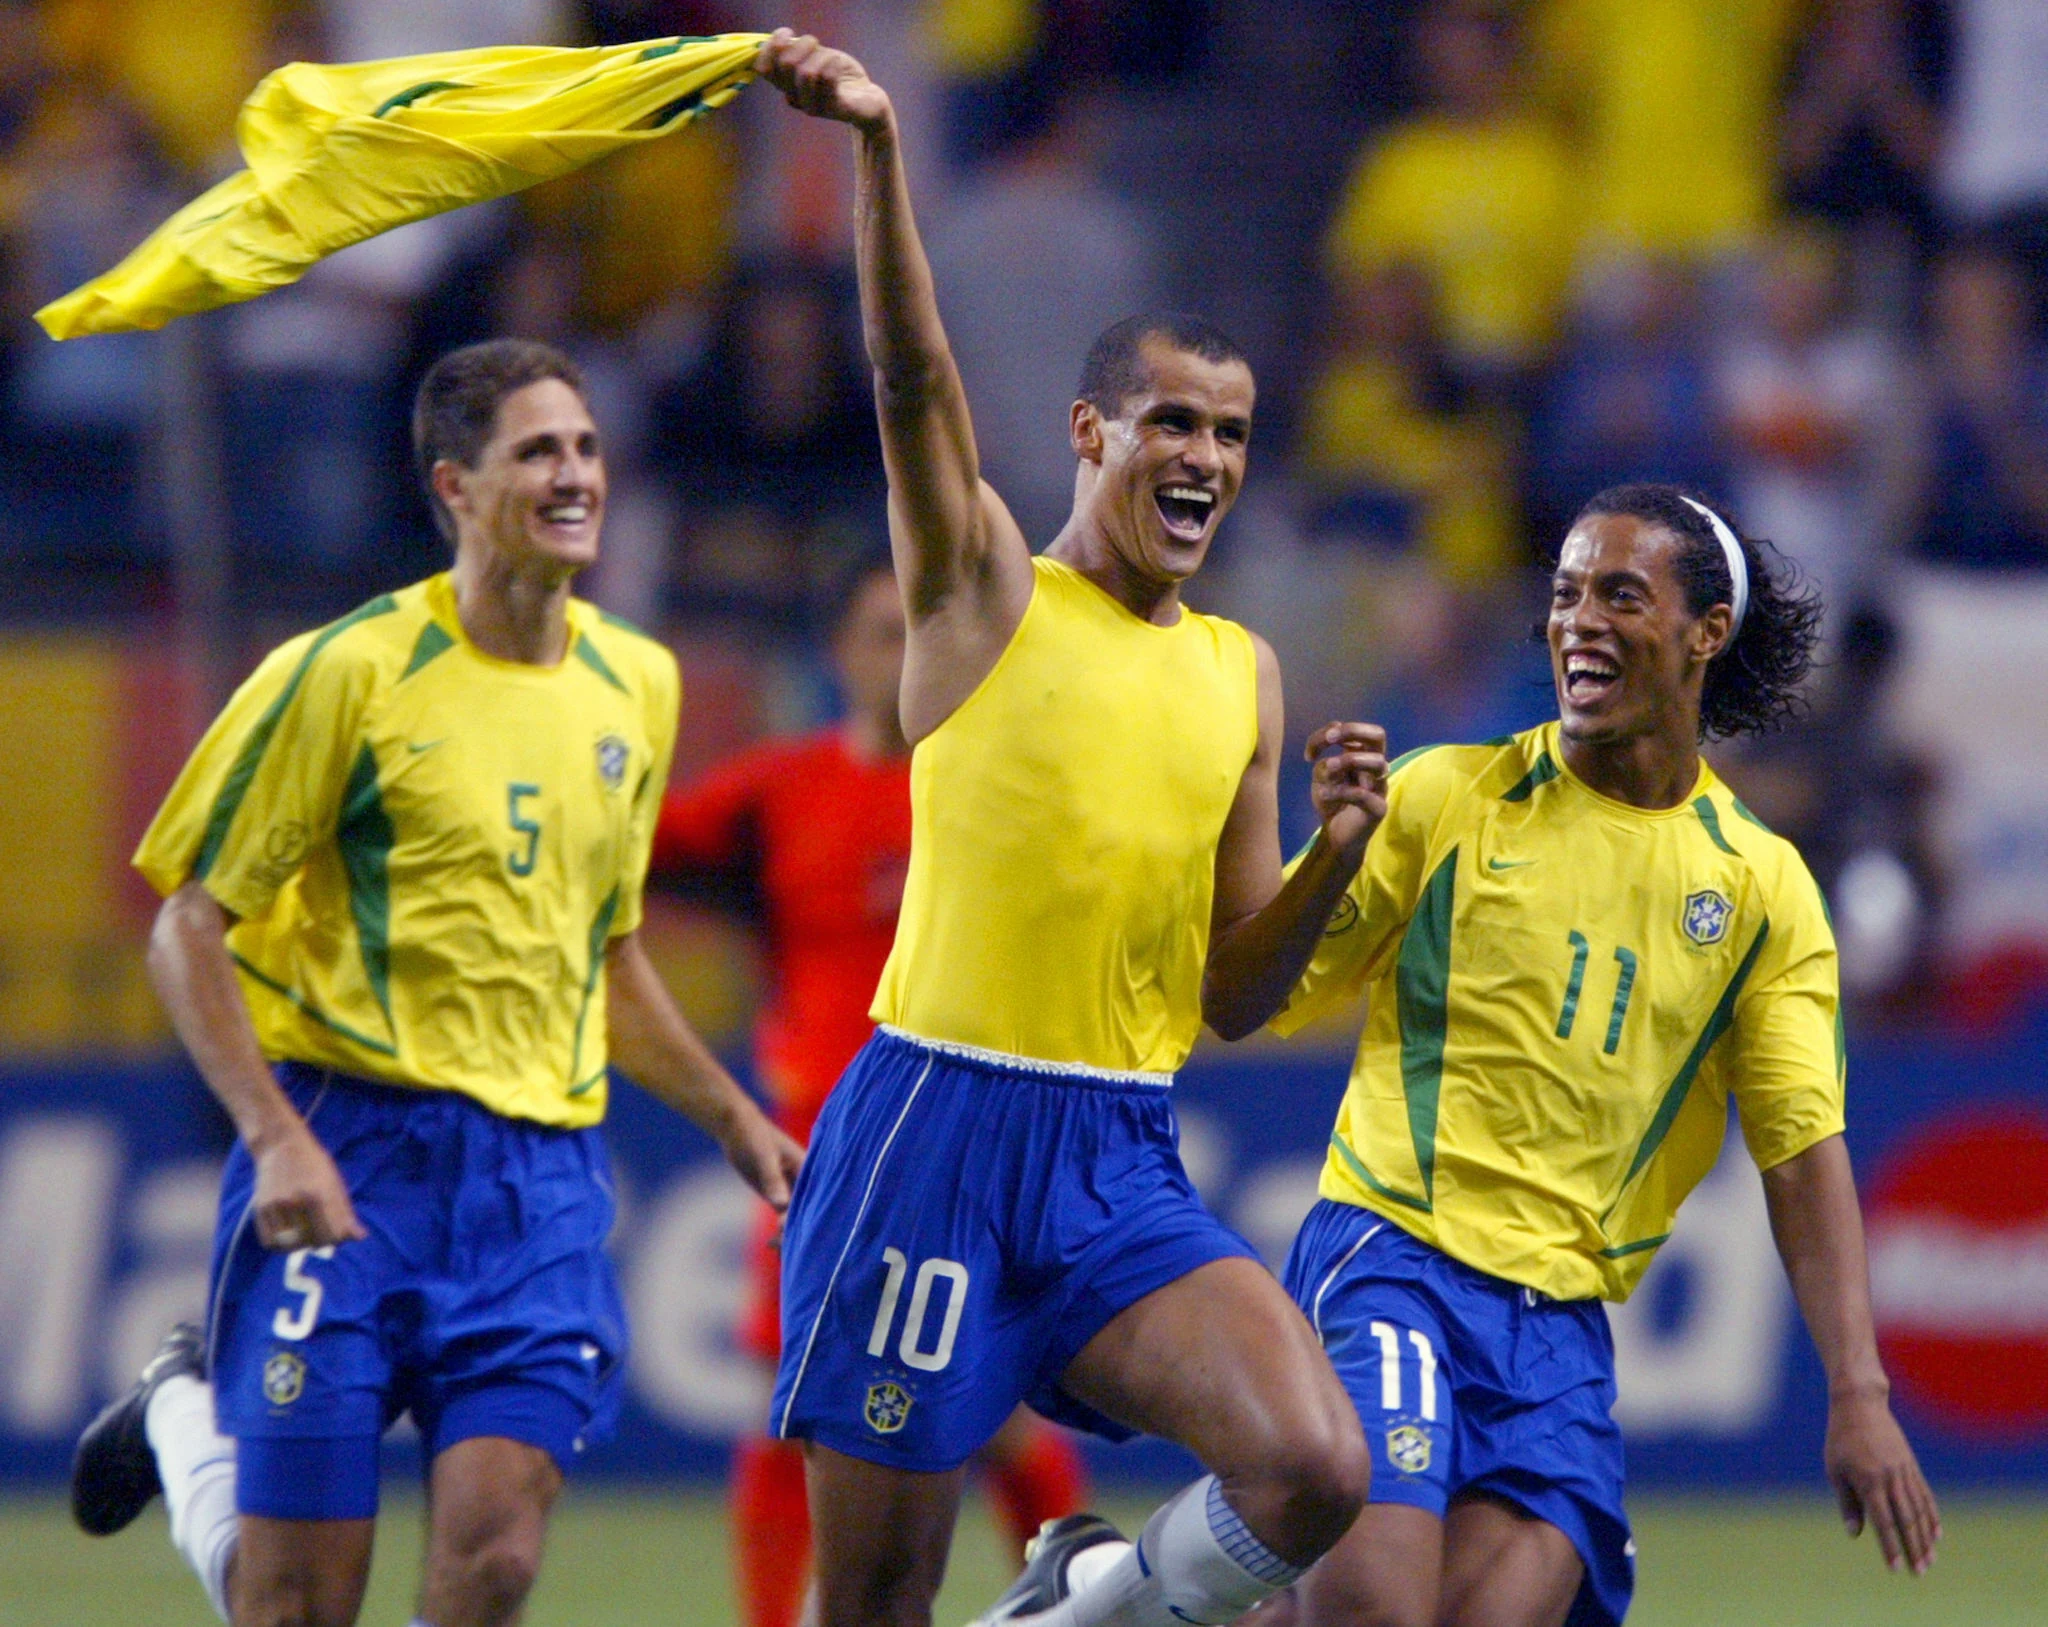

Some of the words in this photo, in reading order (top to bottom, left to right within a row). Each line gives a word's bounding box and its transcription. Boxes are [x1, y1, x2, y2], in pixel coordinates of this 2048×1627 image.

[507, 783, 541, 877] 5
[1555, 929, 1637, 1056] 11
[272, 1245, 335, 1341] 5
[867, 1246, 969, 1373] 10
[1369, 1320, 1438, 1422] 11
